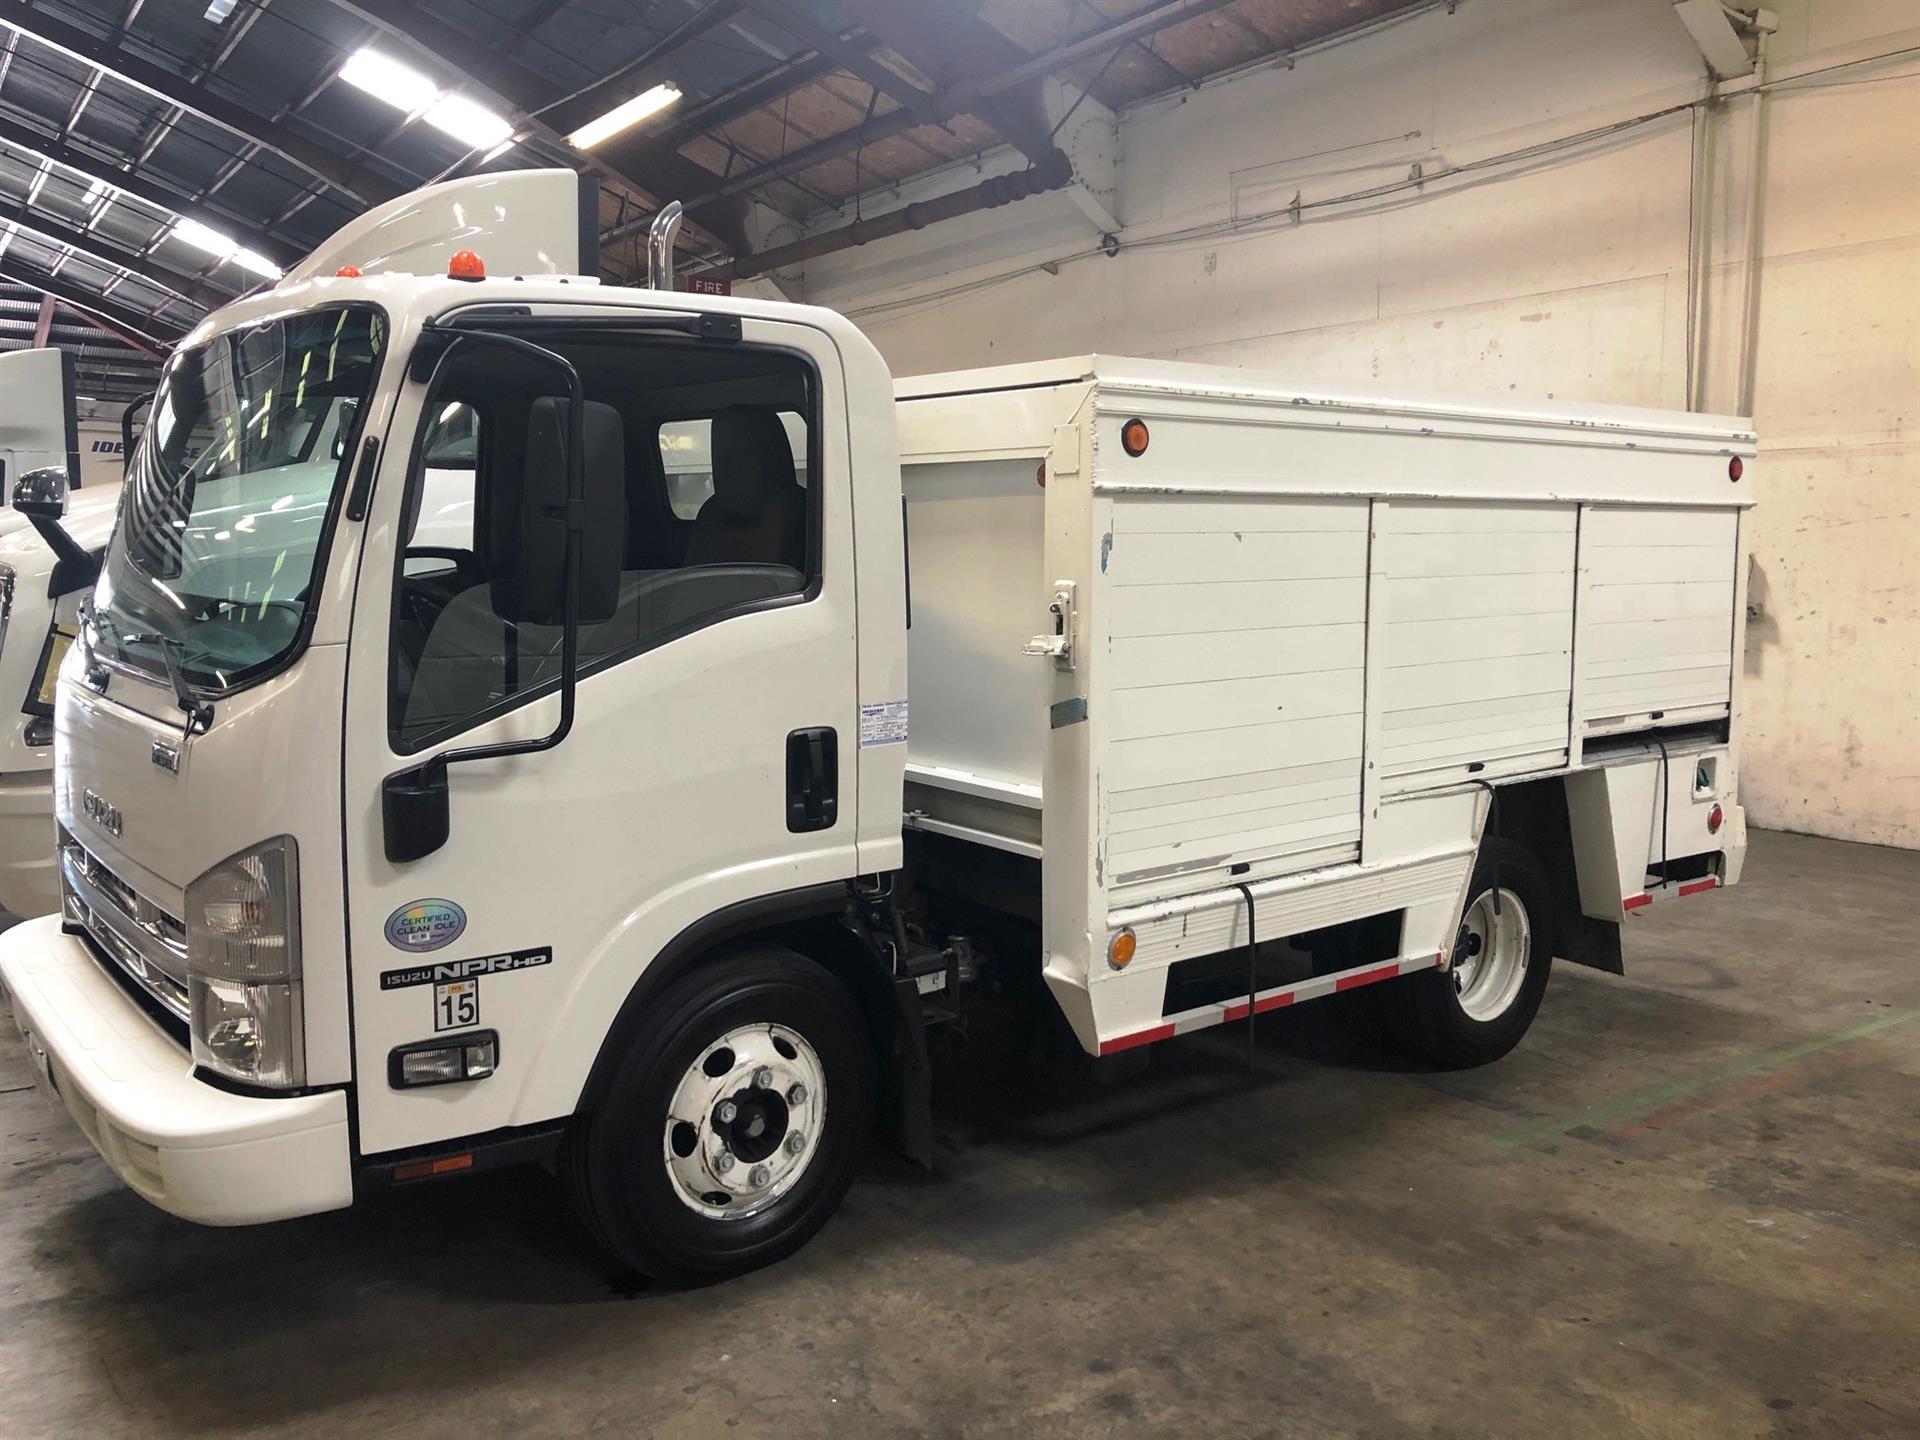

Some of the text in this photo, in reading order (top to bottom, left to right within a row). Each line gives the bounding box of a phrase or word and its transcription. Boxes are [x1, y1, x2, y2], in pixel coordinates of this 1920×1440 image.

[695, 280, 723, 294] FIRE
[401, 913, 451, 926] CERTIFIED
[397, 920, 456, 935] CLEAN IDLE
[387, 970, 431, 985] ISUZU
[441, 992, 475, 1026] 15
